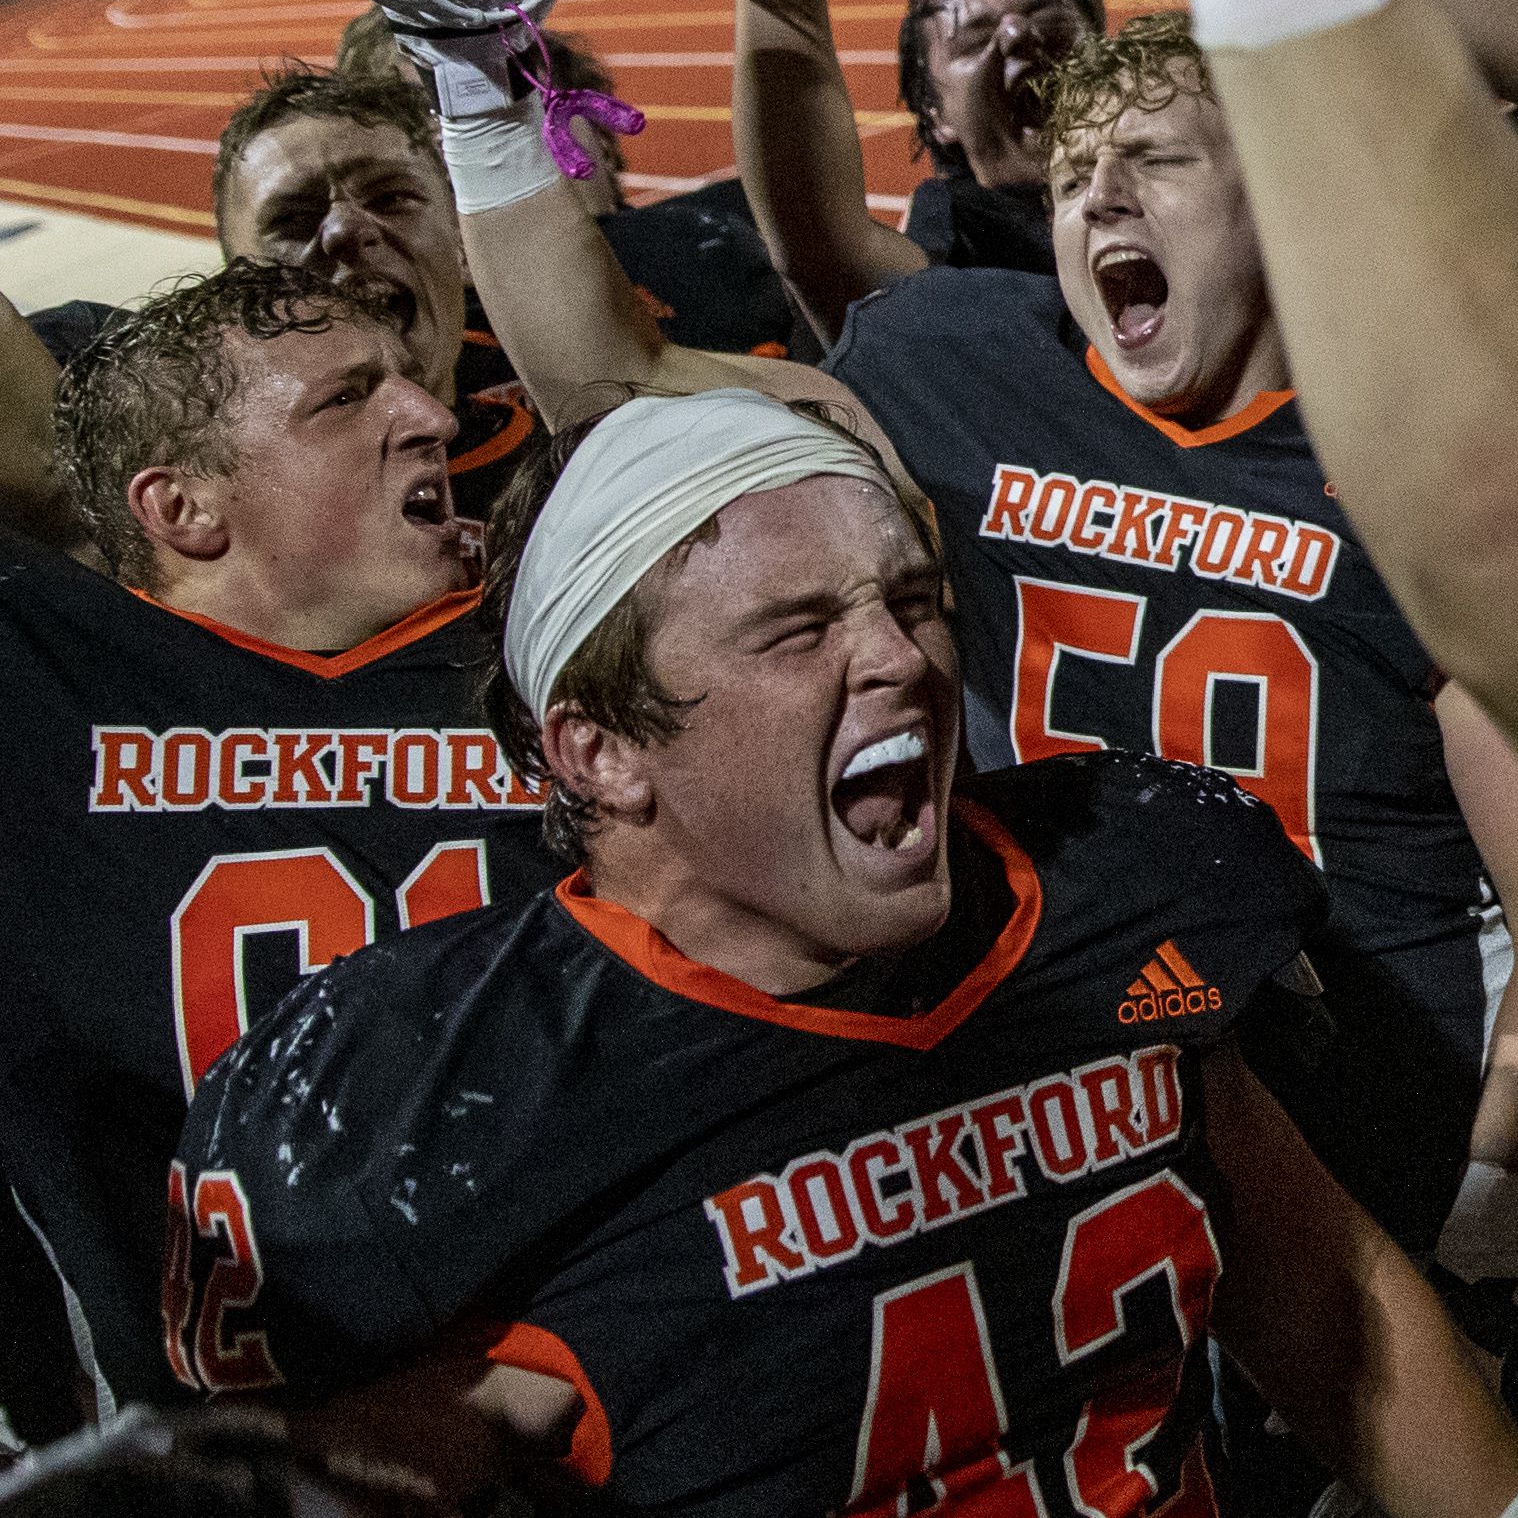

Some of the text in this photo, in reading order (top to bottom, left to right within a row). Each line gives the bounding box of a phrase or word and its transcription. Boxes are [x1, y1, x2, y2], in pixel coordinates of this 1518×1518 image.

[979, 463, 1341, 603] ROCKFORD
[171, 837, 491, 1102] 6
[1118, 985, 1223, 1024] adidas
[703, 1044, 1184, 1301] ROCKFORD
[822, 1167, 1224, 1518] 42
